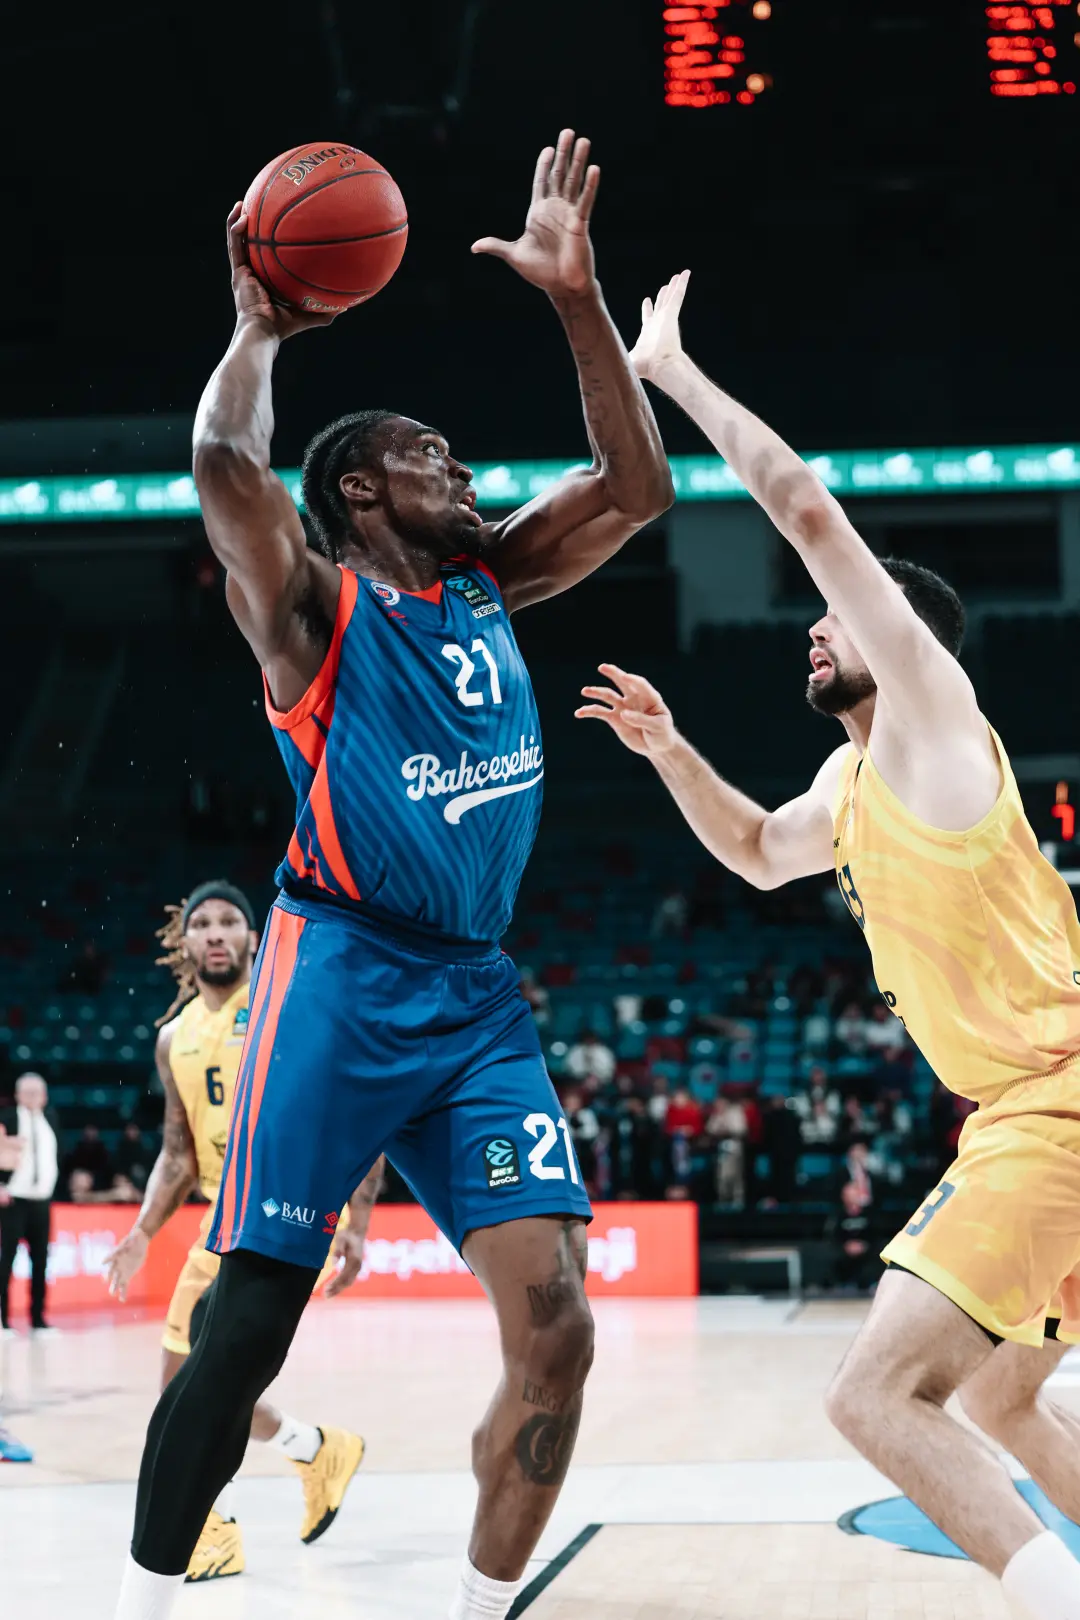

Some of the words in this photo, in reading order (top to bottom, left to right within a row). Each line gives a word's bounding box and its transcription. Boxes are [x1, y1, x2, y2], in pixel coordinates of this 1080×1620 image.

[441, 638, 503, 708] 21
[401, 734, 543, 801] Bahçeşehir
[205, 1066, 225, 1107] 6
[522, 1112, 579, 1185] 21
[489, 1175, 519, 1187] EuroCup
[491, 1166, 515, 1179] BKT
[281, 1201, 316, 1224] BAU
